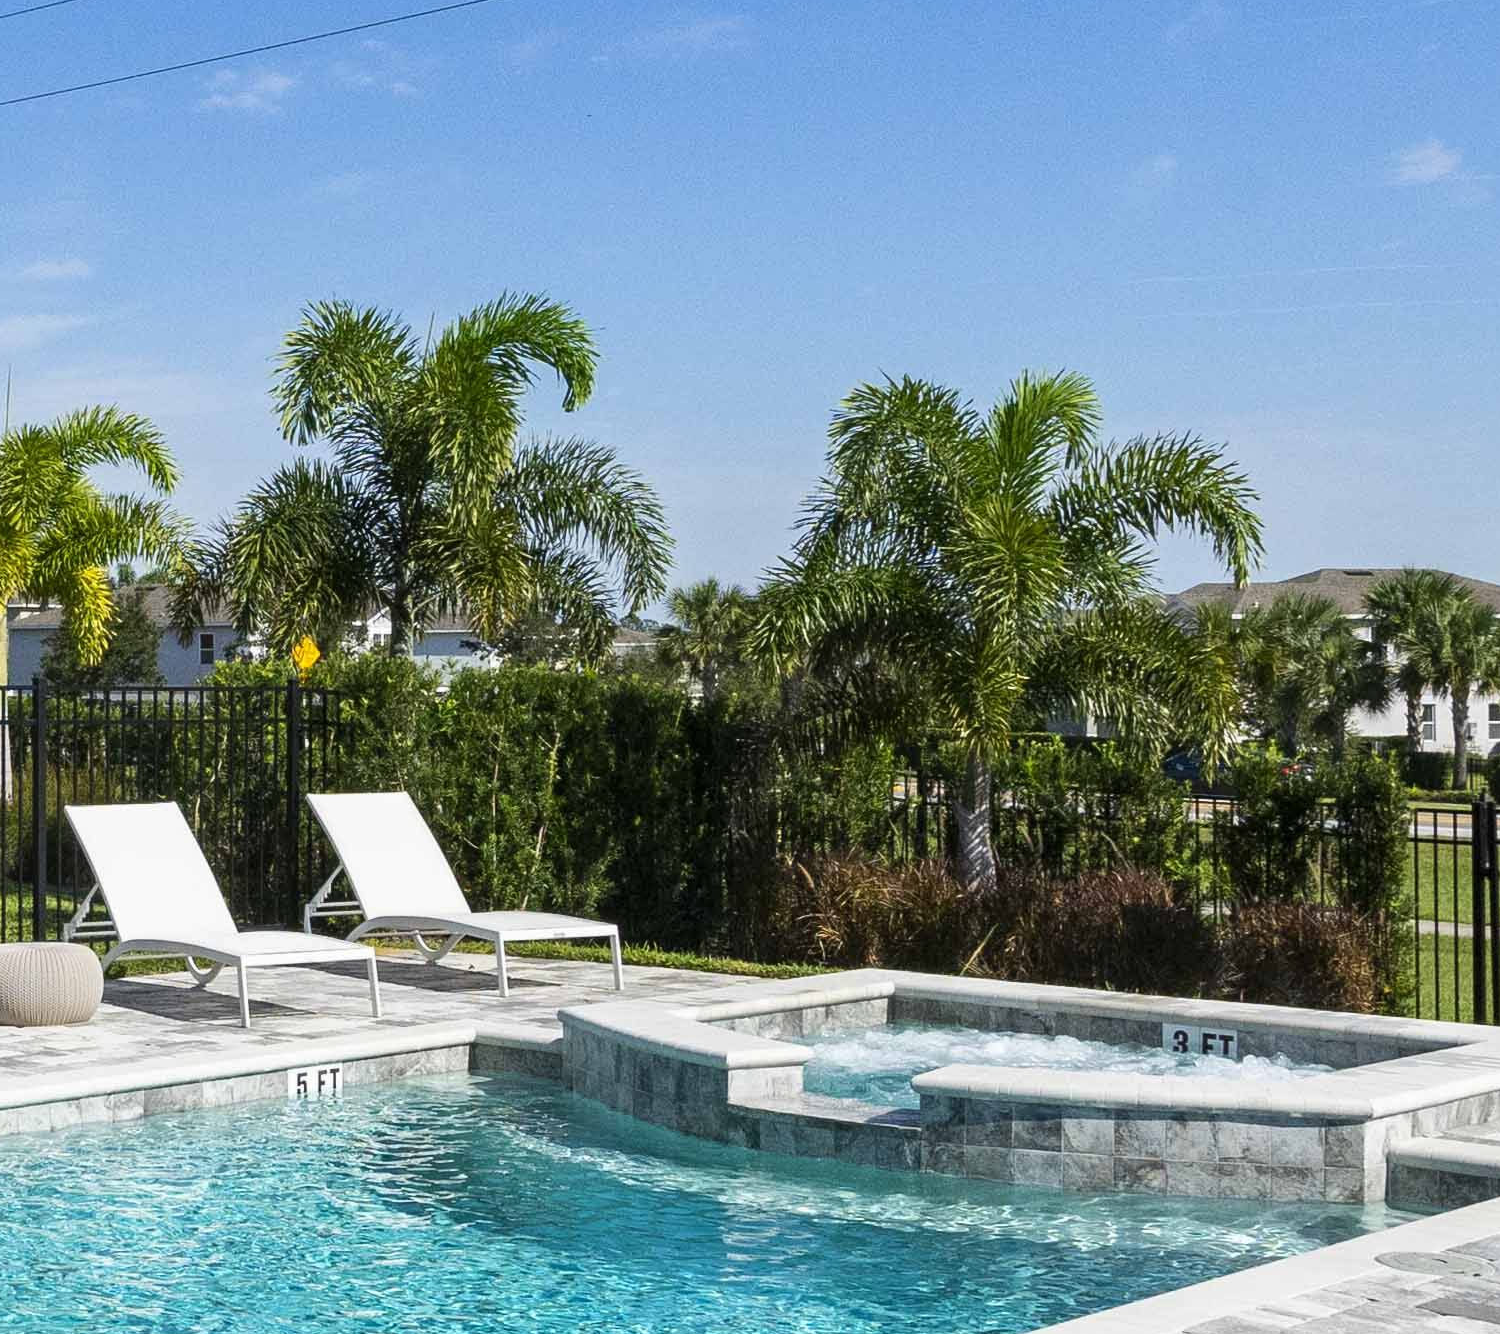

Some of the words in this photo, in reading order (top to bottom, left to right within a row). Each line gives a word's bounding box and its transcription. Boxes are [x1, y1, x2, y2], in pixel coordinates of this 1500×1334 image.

[1172, 1030, 1188, 1054] 3
[1202, 1033, 1235, 1055] FT
[297, 1072, 307, 1094] 5
[318, 1068, 340, 1092] FT
